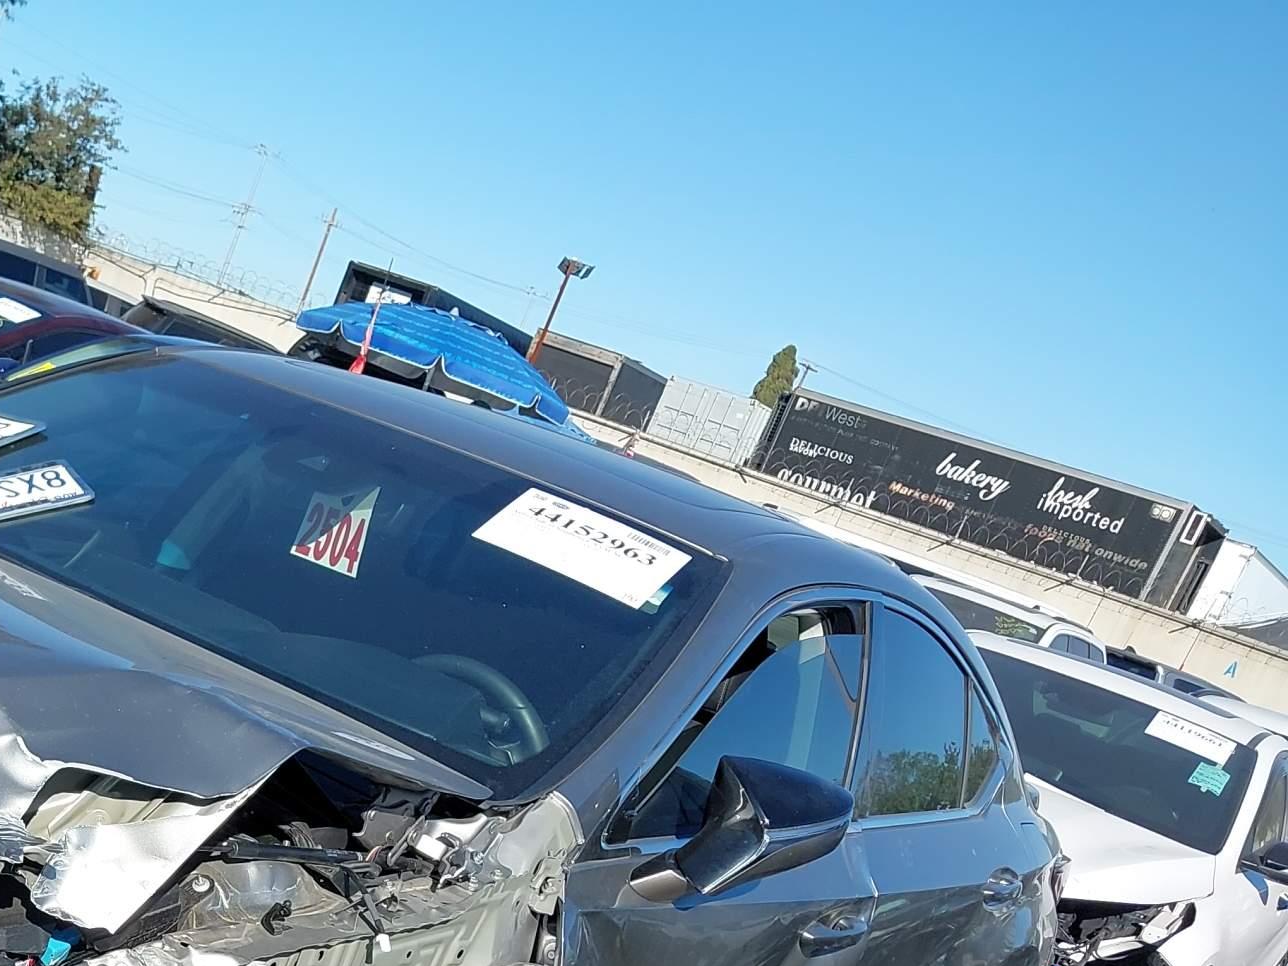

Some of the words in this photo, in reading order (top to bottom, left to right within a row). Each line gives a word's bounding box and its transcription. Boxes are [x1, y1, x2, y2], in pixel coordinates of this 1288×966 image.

[826, 405, 860, 428] West
[790, 437, 854, 464] DELICIOUS
[935, 452, 1011, 501] bakery
[1045, 476, 1100, 510] fresh
[888, 481, 955, 510] Marketing
[1037, 493, 1125, 534] imported
[295, 502, 367, 574] 2504
[528, 505, 657, 568] 44152963
[1223, 660, 1238, 679] A
